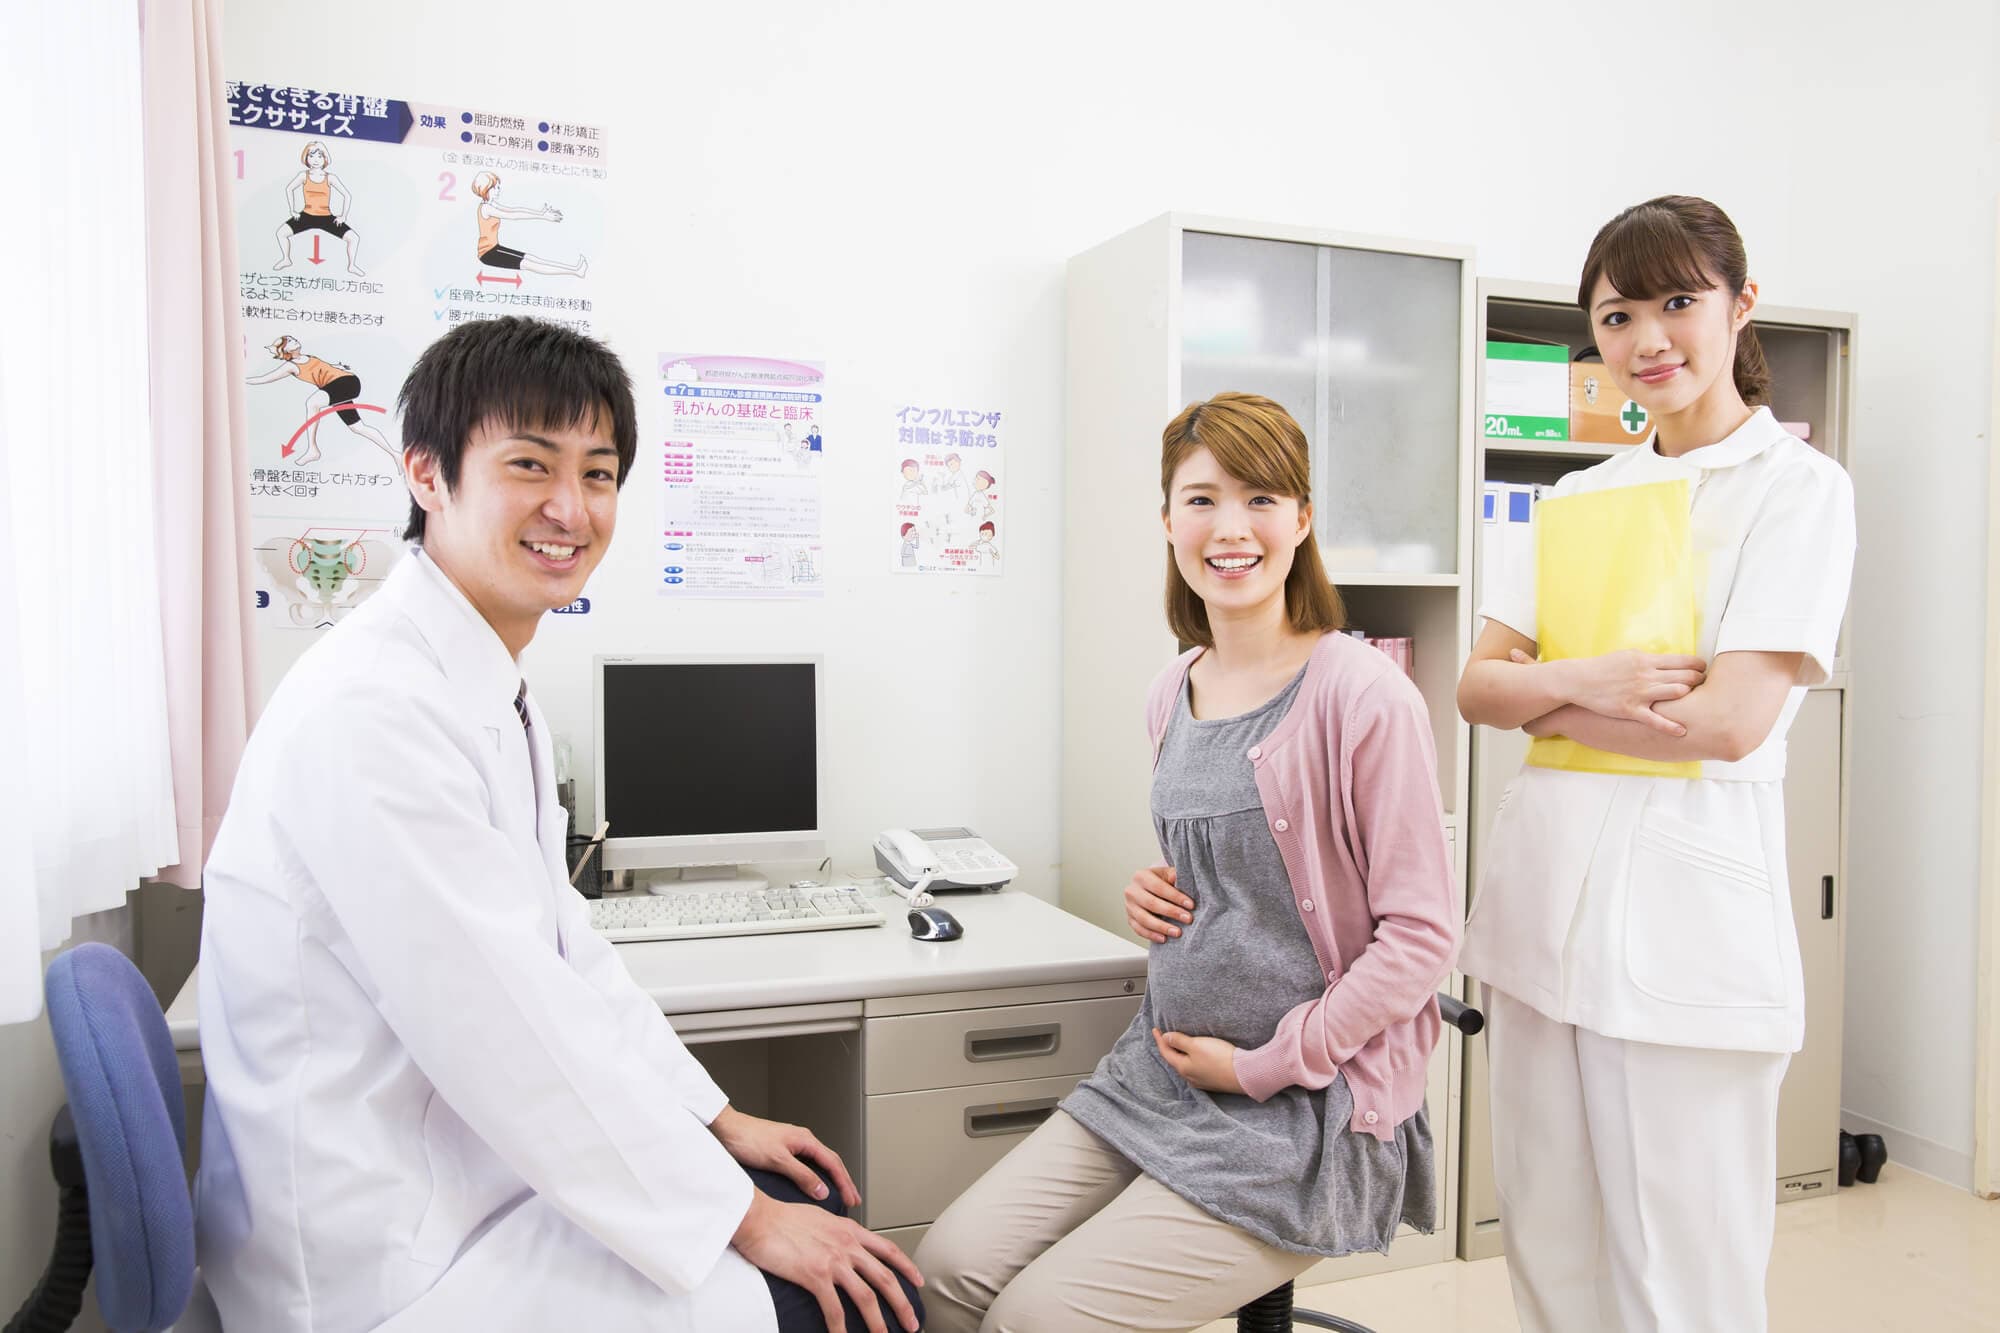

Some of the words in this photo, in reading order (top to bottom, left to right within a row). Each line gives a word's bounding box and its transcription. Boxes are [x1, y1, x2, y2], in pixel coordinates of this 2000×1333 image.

[420, 114, 446, 129] 効果
[474, 113, 526, 132] 脂肪燃焼
[551, 124, 600, 141] 体形矯正
[473, 132, 533, 151] 肩こり解消
[551, 142, 600, 159] 腰痛予防
[234, 150, 245, 180] 1
[438, 171, 457, 201] 2
[240, 272, 384, 294] ザとつま先が同じ方向に
[450, 288, 592, 312] 座骨をつけたまま前後移動
[242, 305, 384, 326] 軟性に合わせ腰をおろす
[673, 400, 814, 421] 乳がんの基礎と臨床
[896, 405, 1001, 429] インフルエンザ
